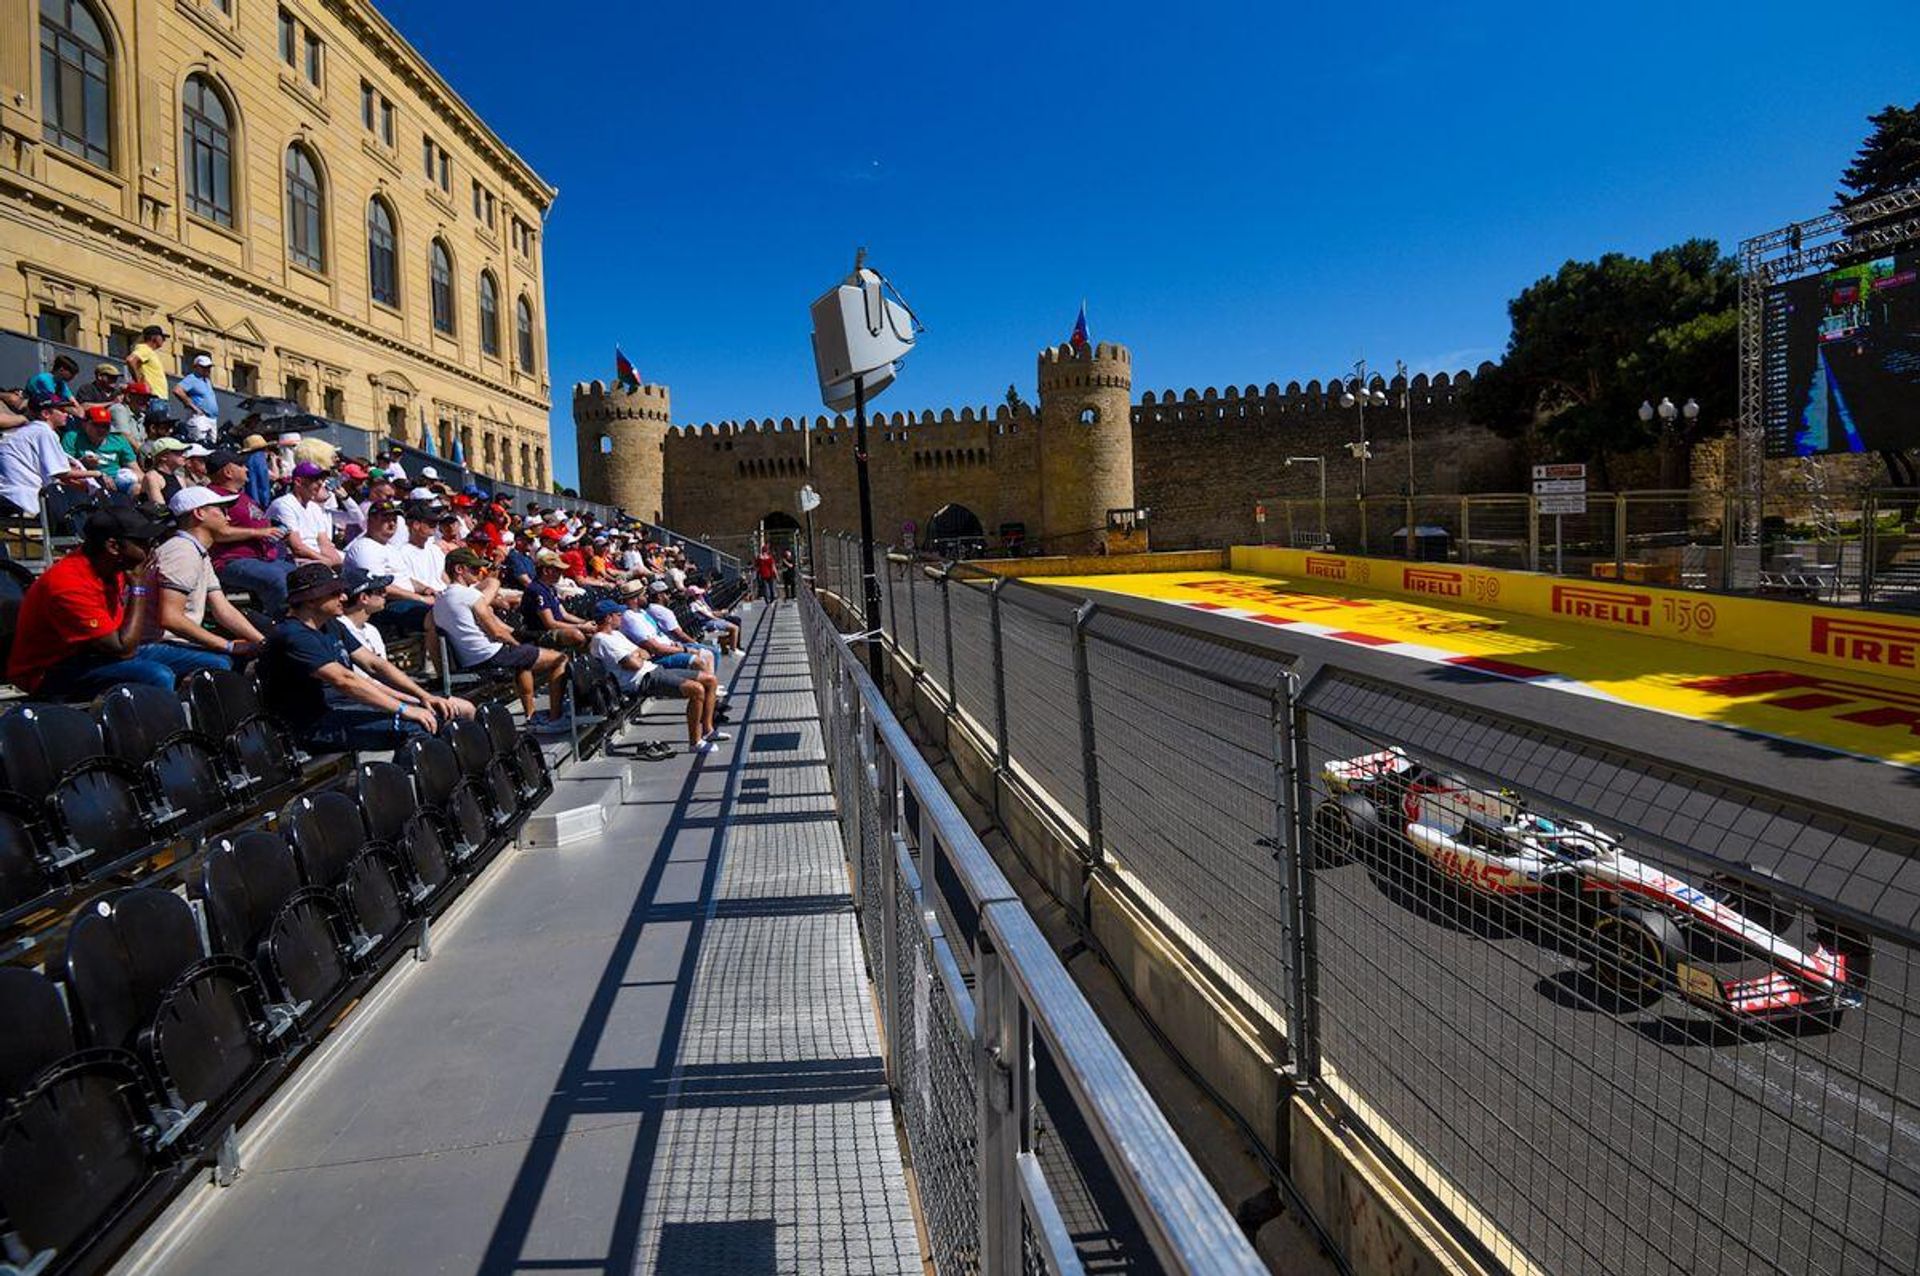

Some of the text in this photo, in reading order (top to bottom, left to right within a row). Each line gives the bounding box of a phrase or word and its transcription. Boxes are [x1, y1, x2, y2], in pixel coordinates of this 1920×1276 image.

[1306, 556, 1346, 580] PIRELLI
[1404, 568, 1499, 600] PIRELLI 150
[1552, 585, 1716, 633] PIRELLI 150
[1811, 615, 1920, 668] PIRE
